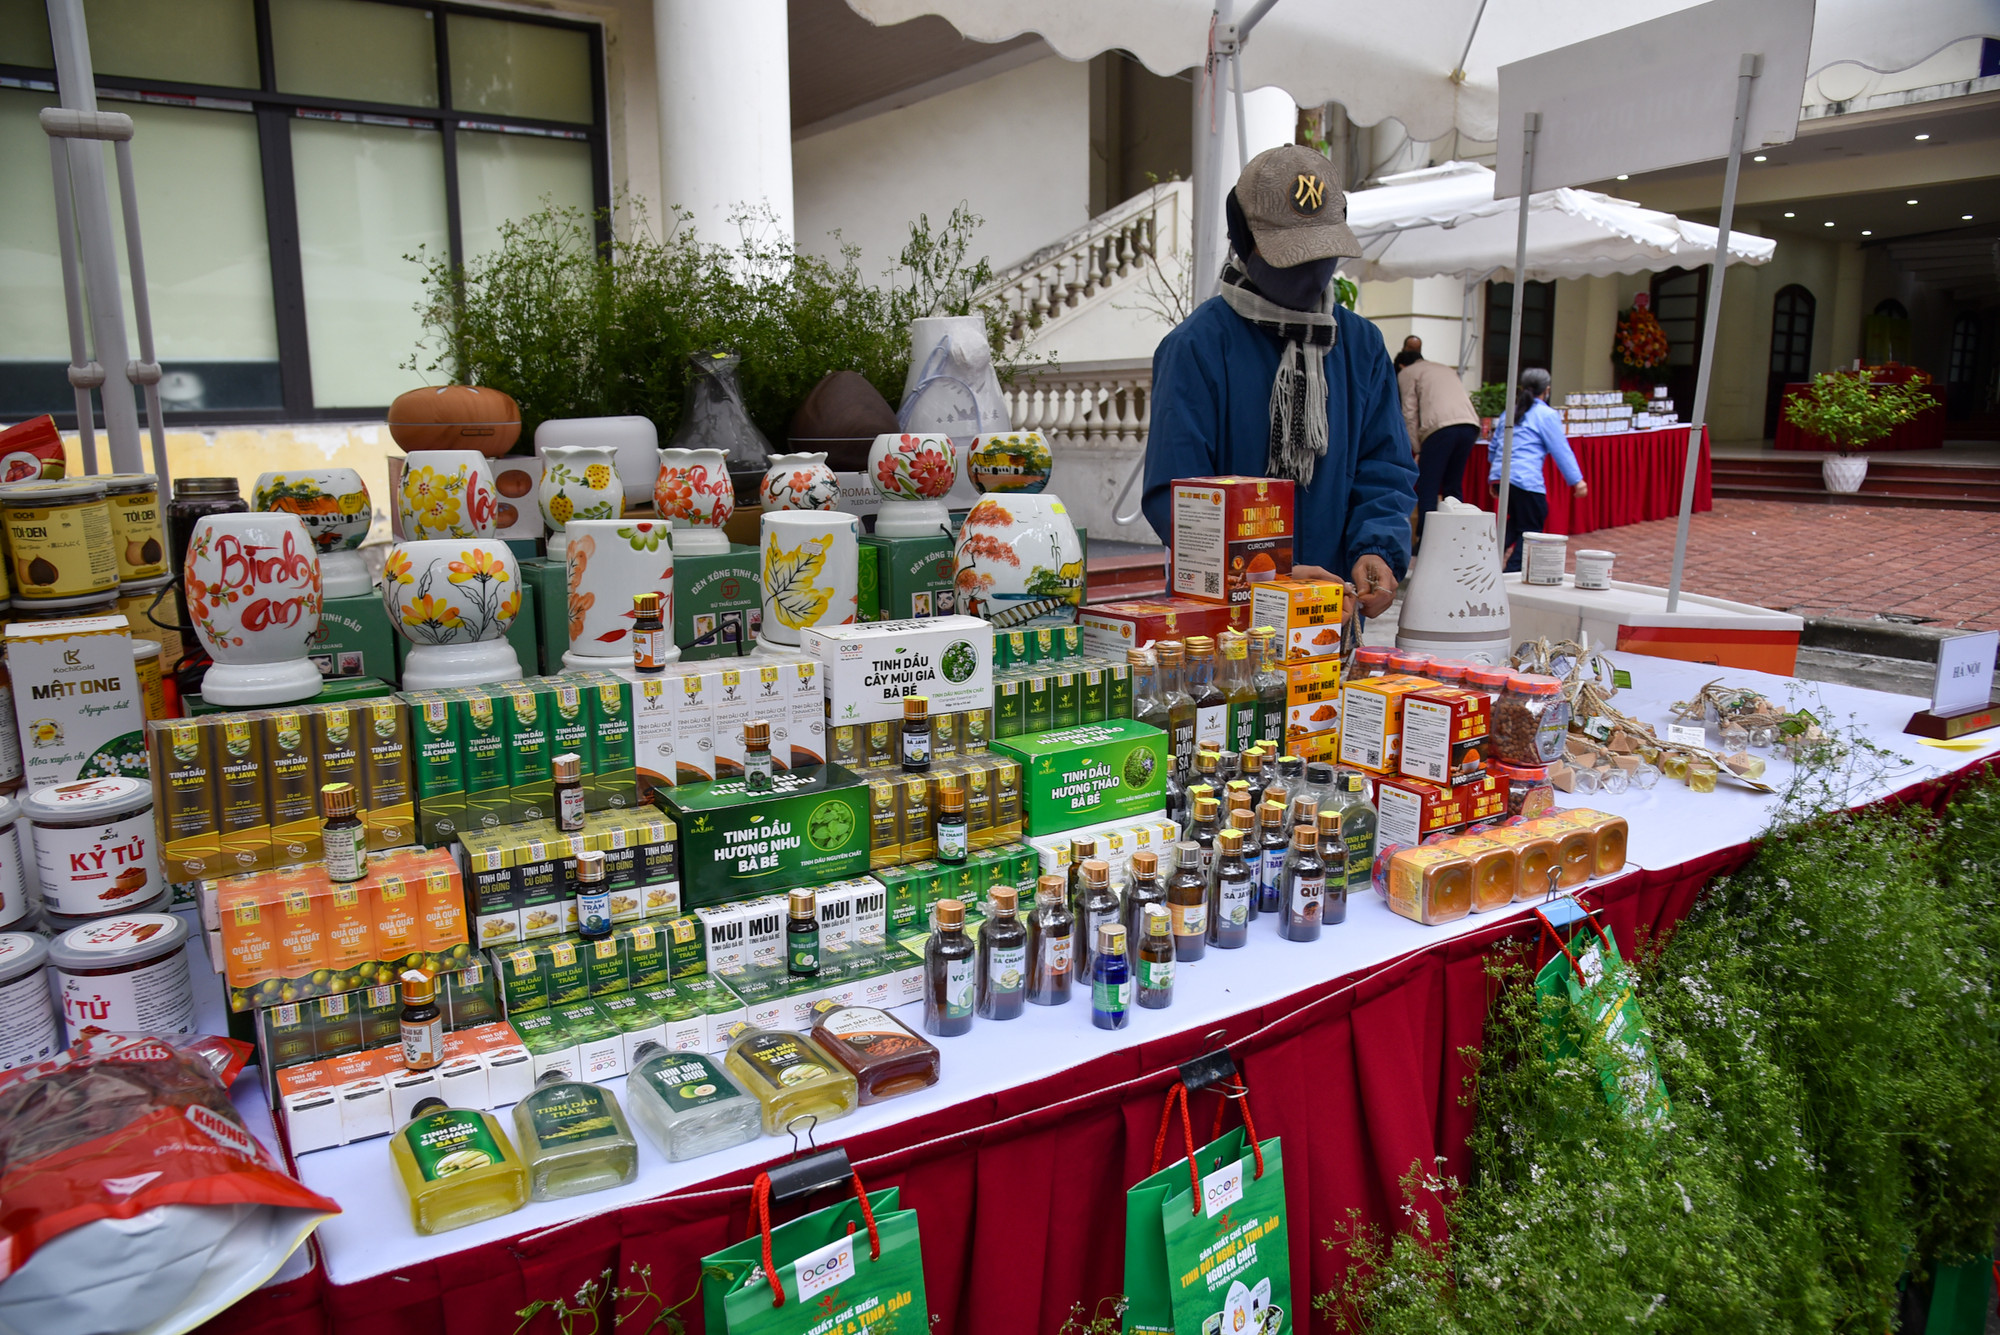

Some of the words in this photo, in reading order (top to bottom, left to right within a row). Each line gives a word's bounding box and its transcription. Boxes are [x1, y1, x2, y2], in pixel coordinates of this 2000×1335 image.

[1247, 542, 1275, 550] CURCUMIN
[1296, 607, 1309, 616] TINH
[840, 644, 863, 652] OCOP
[53, 664, 95, 673] KochiGold
[872, 660, 901, 671] TINH
[1952, 661, 1965, 679] HÀ
[1966, 661, 1981, 677] NỘI
[864, 674, 890, 687] CÂY
[891, 670, 913, 684] MÙI
[915, 669, 936, 680] GIÀ
[32, 679, 77, 700] MẬT
[80, 677, 120, 694] ONG
[883, 686, 900, 699] BÀ
[902, 683, 917, 697] BÉ
[1294, 684, 1308, 694] TINH
[1237, 709, 1253, 724] TINH
[1264, 712, 1281, 727] TINH
[607, 726, 629, 735] CHANH
[1175, 725, 1193, 741] TINH
[432, 748, 457, 756] CHANH
[288, 764, 307, 772] JAVA
[1061, 770, 1088, 784] TINH
[1051, 785, 1090, 800] HƯƠNG
[1092, 776, 1120, 793] THẢO
[1071, 796, 1086, 810] BÀ
[1087, 791, 1101, 805] BÉ
[723, 829, 758, 844] TINH
[70, 845, 107, 872] KỶ
[112, 835, 145, 865] TỬ
[713, 841, 769, 862] HƯƠNG
[770, 835, 801, 851] NHU
[738, 857, 761, 873] BÀ
[762, 853, 779, 868] BÉ
[855, 893, 884, 915] MÙI
[711, 921, 743, 944] MÙI
[749, 914, 780, 937] MÙI
[859, 923, 879, 933] OCOP
[716, 953, 739, 963] OCOP
[753, 946, 776, 957] OCOP
[866, 983, 888, 993] OCOP
[756, 1009, 779, 1020] OCOP
[536, 1104, 569, 1116] TINH
[438, 1128, 478, 1140] CHANH
[1208, 1177, 1238, 1199] OCOP
[1181, 1267, 1199, 1288] TINH
[1244, 1226, 1263, 1245] TINH
[803, 1252, 848, 1281] OCOP
